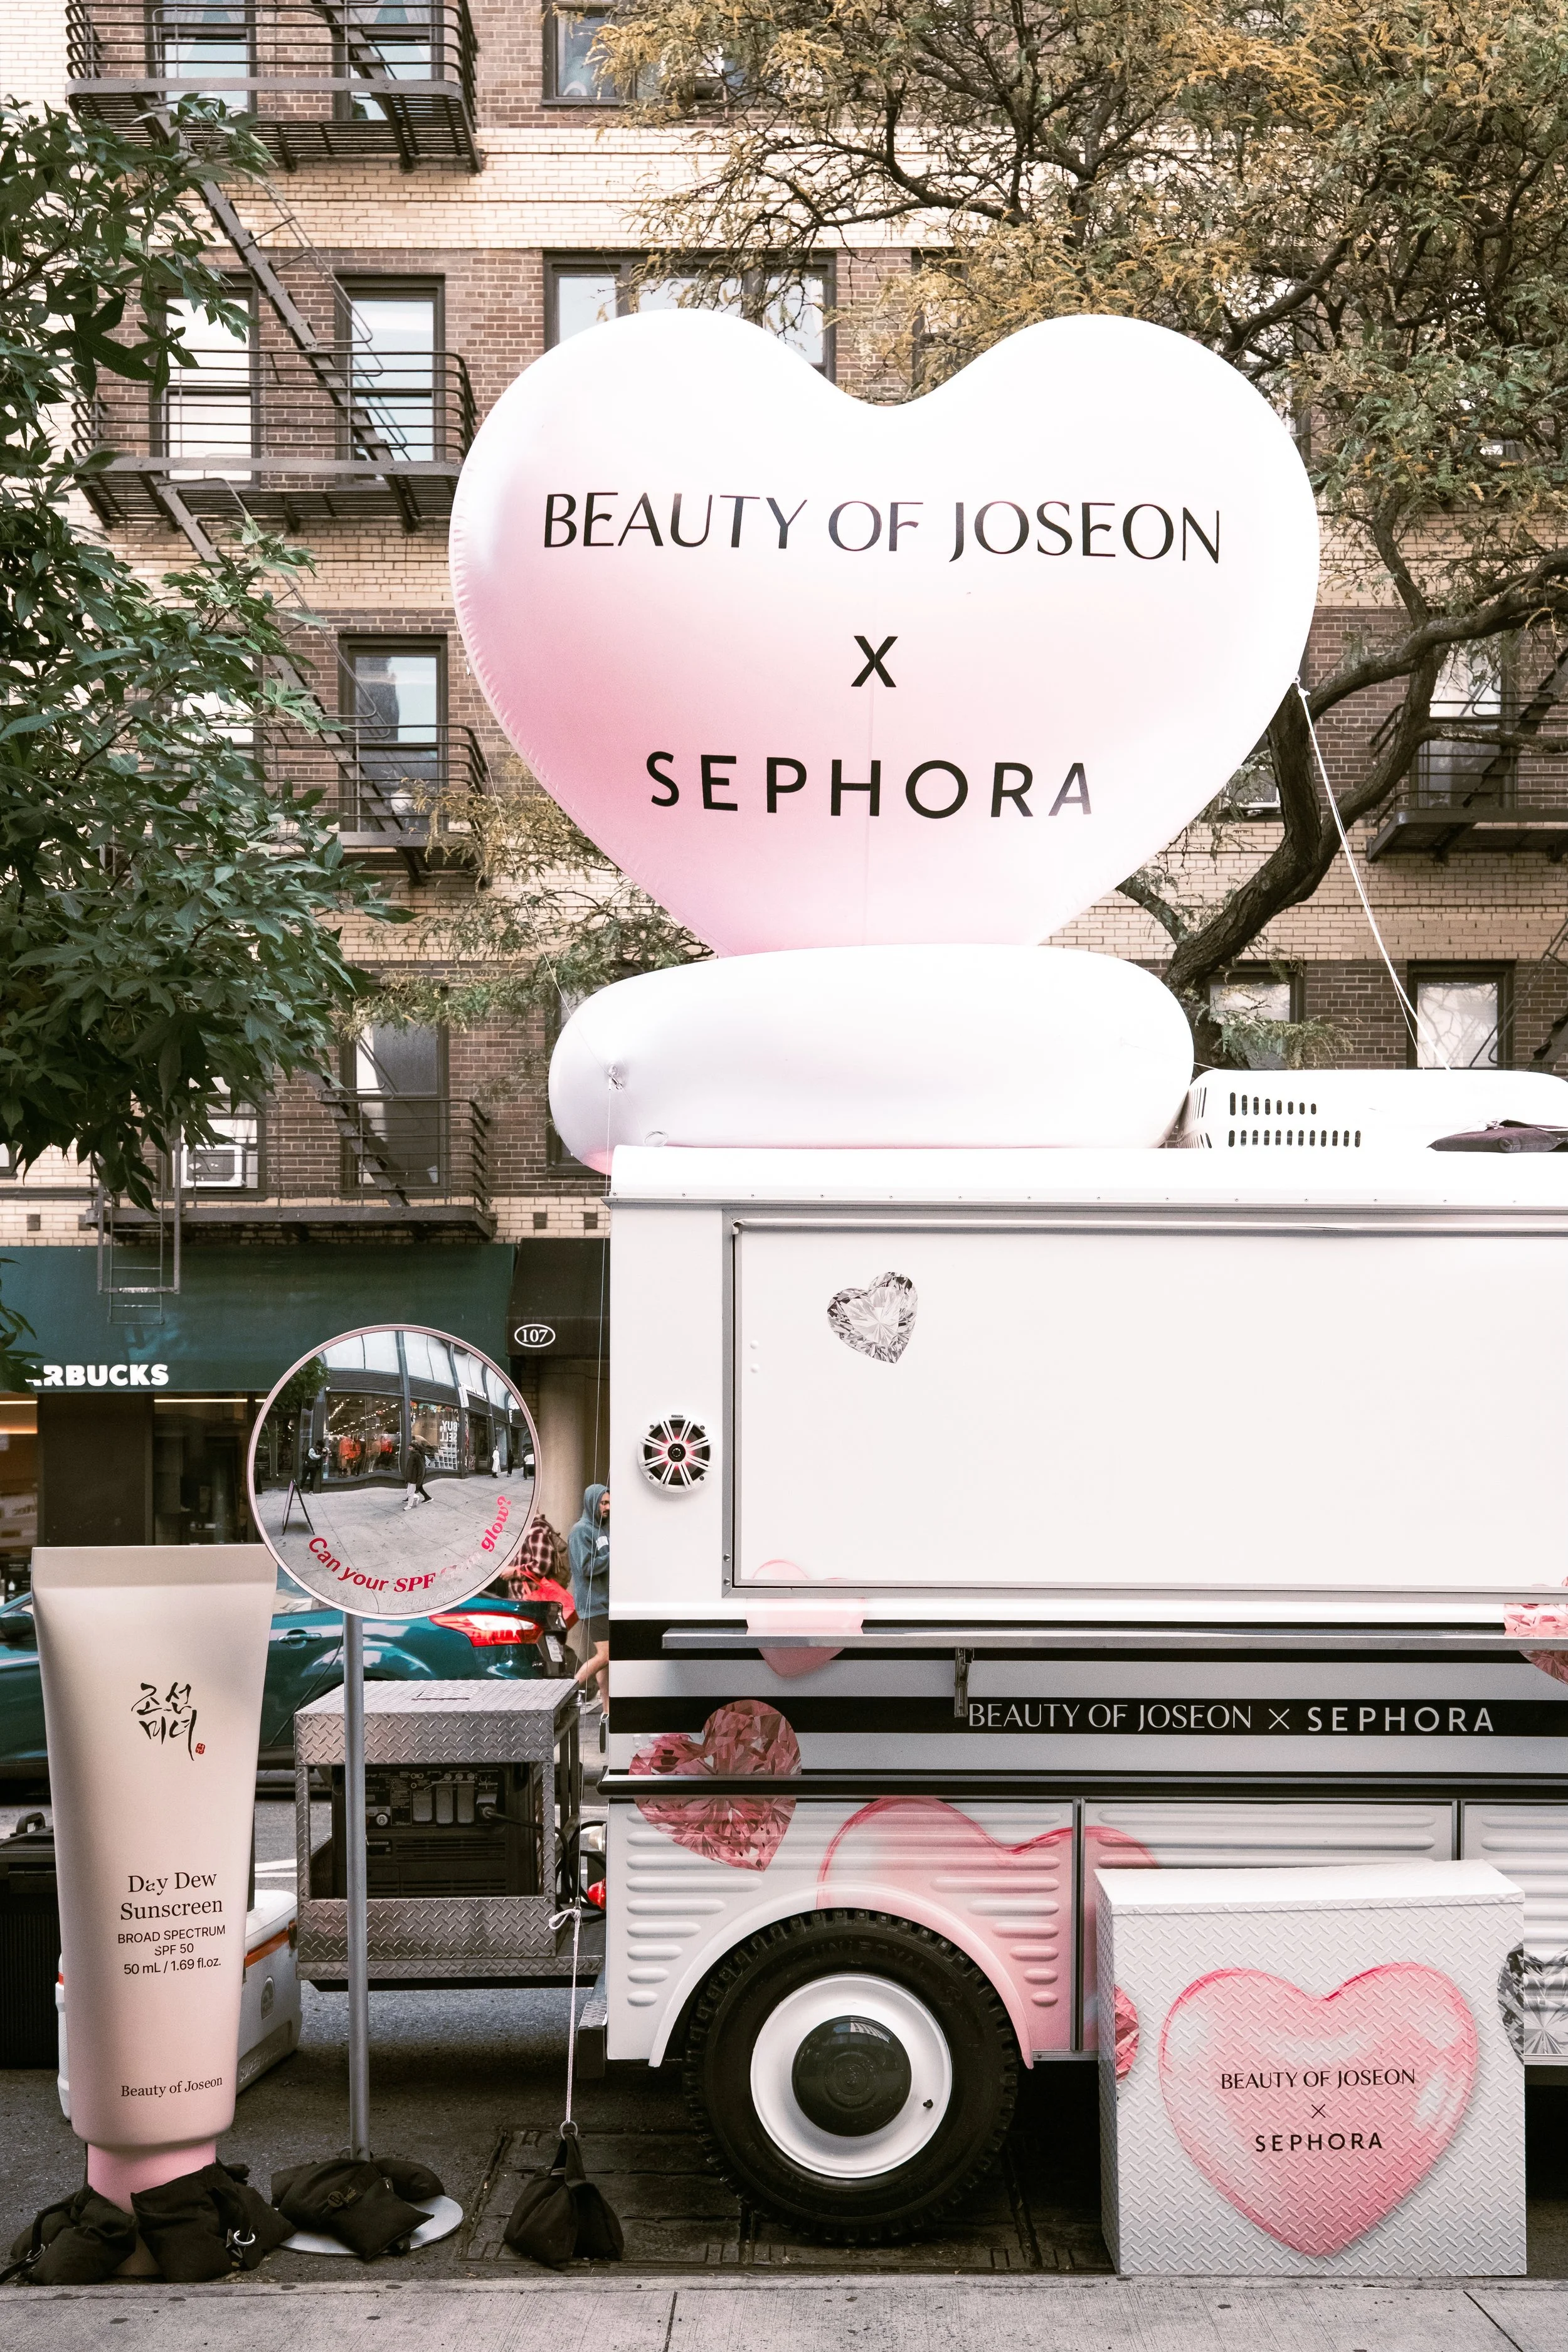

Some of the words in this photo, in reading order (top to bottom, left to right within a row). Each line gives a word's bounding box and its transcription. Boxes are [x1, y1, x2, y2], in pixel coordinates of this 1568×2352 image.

[544, 492, 808, 549] BEAUTY
[829, 501, 924, 552] OF
[949, 501, 1221, 564] JOSEON
[851, 636, 898, 688] X
[646, 751, 1092, 818] SEPHORA
[522, 1329, 548, 1342] 107
[26, 1364, 169, 1386] RBUCKS
[309, 1537, 341, 1572] Can
[337, 1566, 389, 1591] your
[393, 1572, 437, 1592] SPF
[481, 1495, 512, 1552] glow?
[969, 1703, 1080, 1727] BEAUTY
[1088, 1704, 1128, 1728] OF
[1138, 1705, 1251, 1732] JOSEON
[1307, 1707, 1494, 1732] SEPHORA
[127, 1875, 169, 1896] Day
[174, 1872, 217, 1889] Dew
[120, 1899, 223, 1920] Sunscreen
[118, 1932, 161, 1944] BROAD
[164, 1925, 225, 1941] SPECTRUM
[154, 1945, 176, 1956] SPF
[180, 1943, 194, 1954] 50
[124, 1963, 139, 1974] 50
[142, 1963, 161, 1974] mL
[171, 1959, 194, 1971] 1.69
[121, 2085, 166, 2097] Beauty
[169, 2080, 182, 2094] of
[184, 2077, 222, 2092] Joseon
[1222, 2072, 1297, 2089] BEAUTY
[1303, 2070, 1330, 2087] OF
[1337, 2069, 1415, 2089] JOSEON
[1256, 2132, 1383, 2153] SEPHORA
